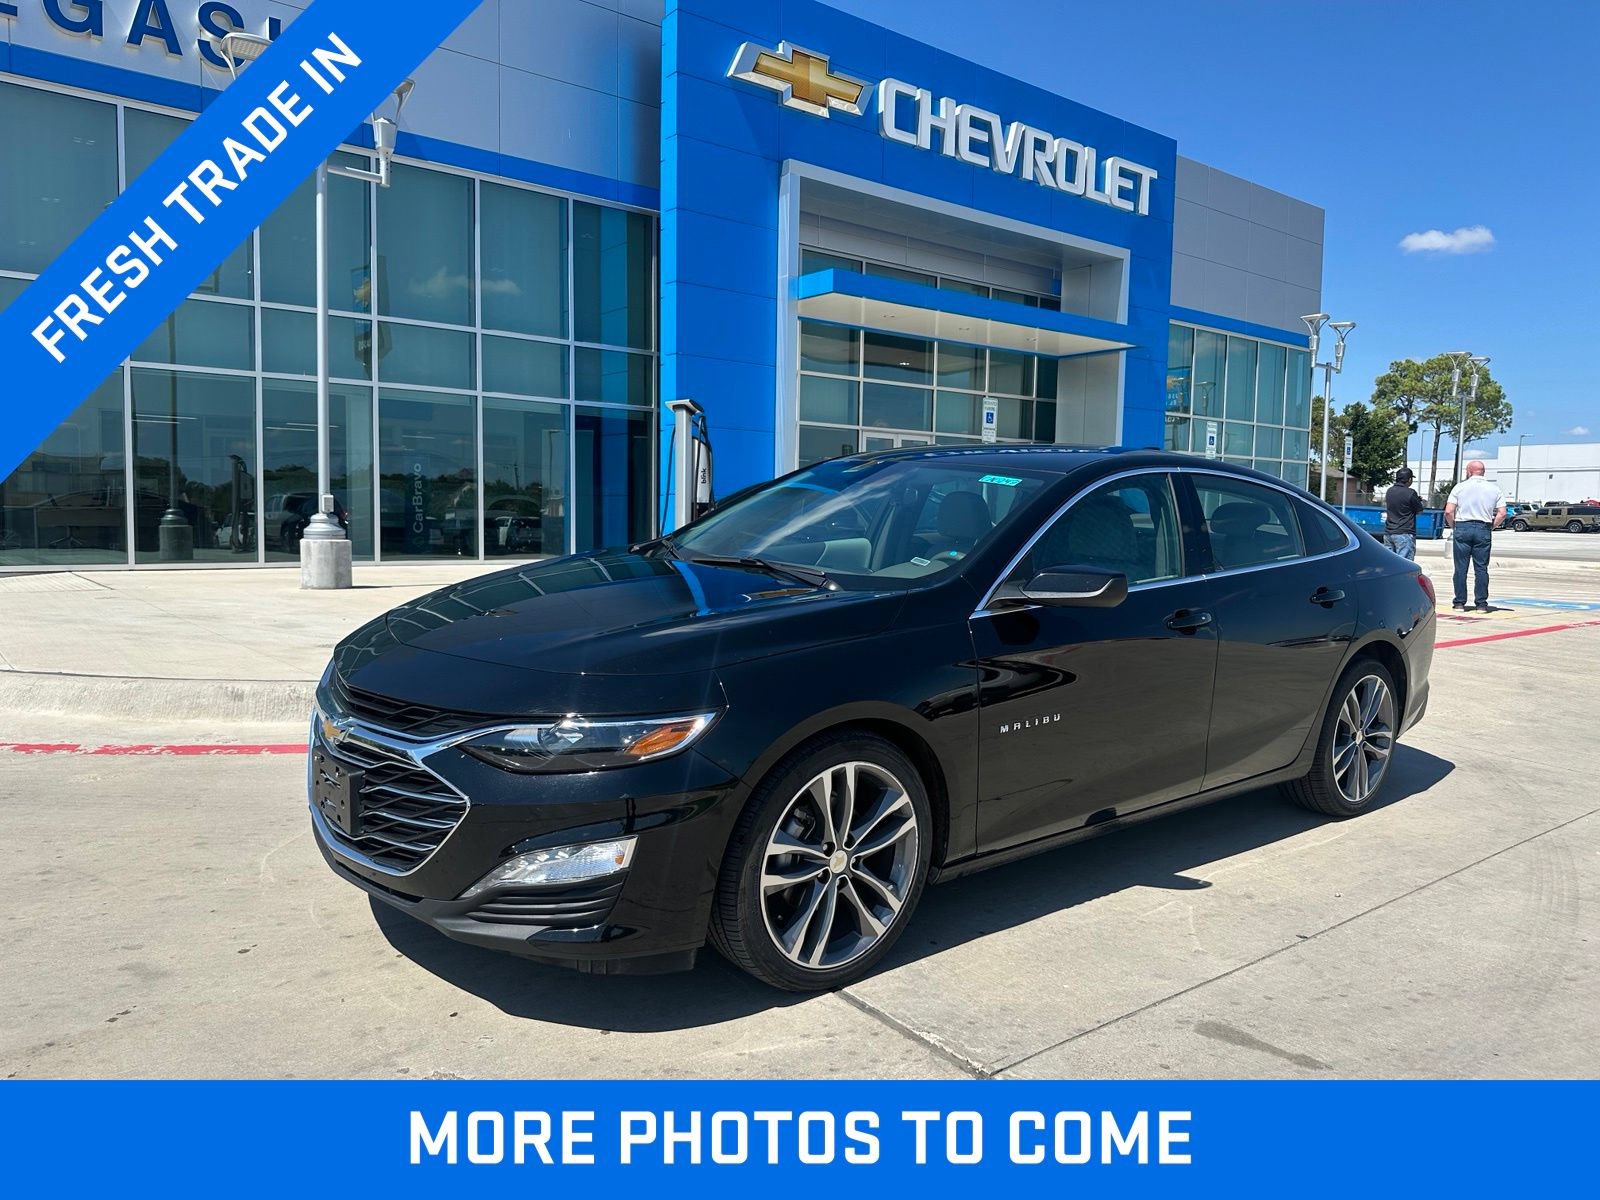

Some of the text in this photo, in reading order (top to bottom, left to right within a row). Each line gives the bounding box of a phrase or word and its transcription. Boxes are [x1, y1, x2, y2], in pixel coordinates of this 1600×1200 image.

[878, 77, 1158, 217] CHEVROLET
[412, 463, 424, 533] CarBravo
[1000, 713, 1061, 734] MALIBU
